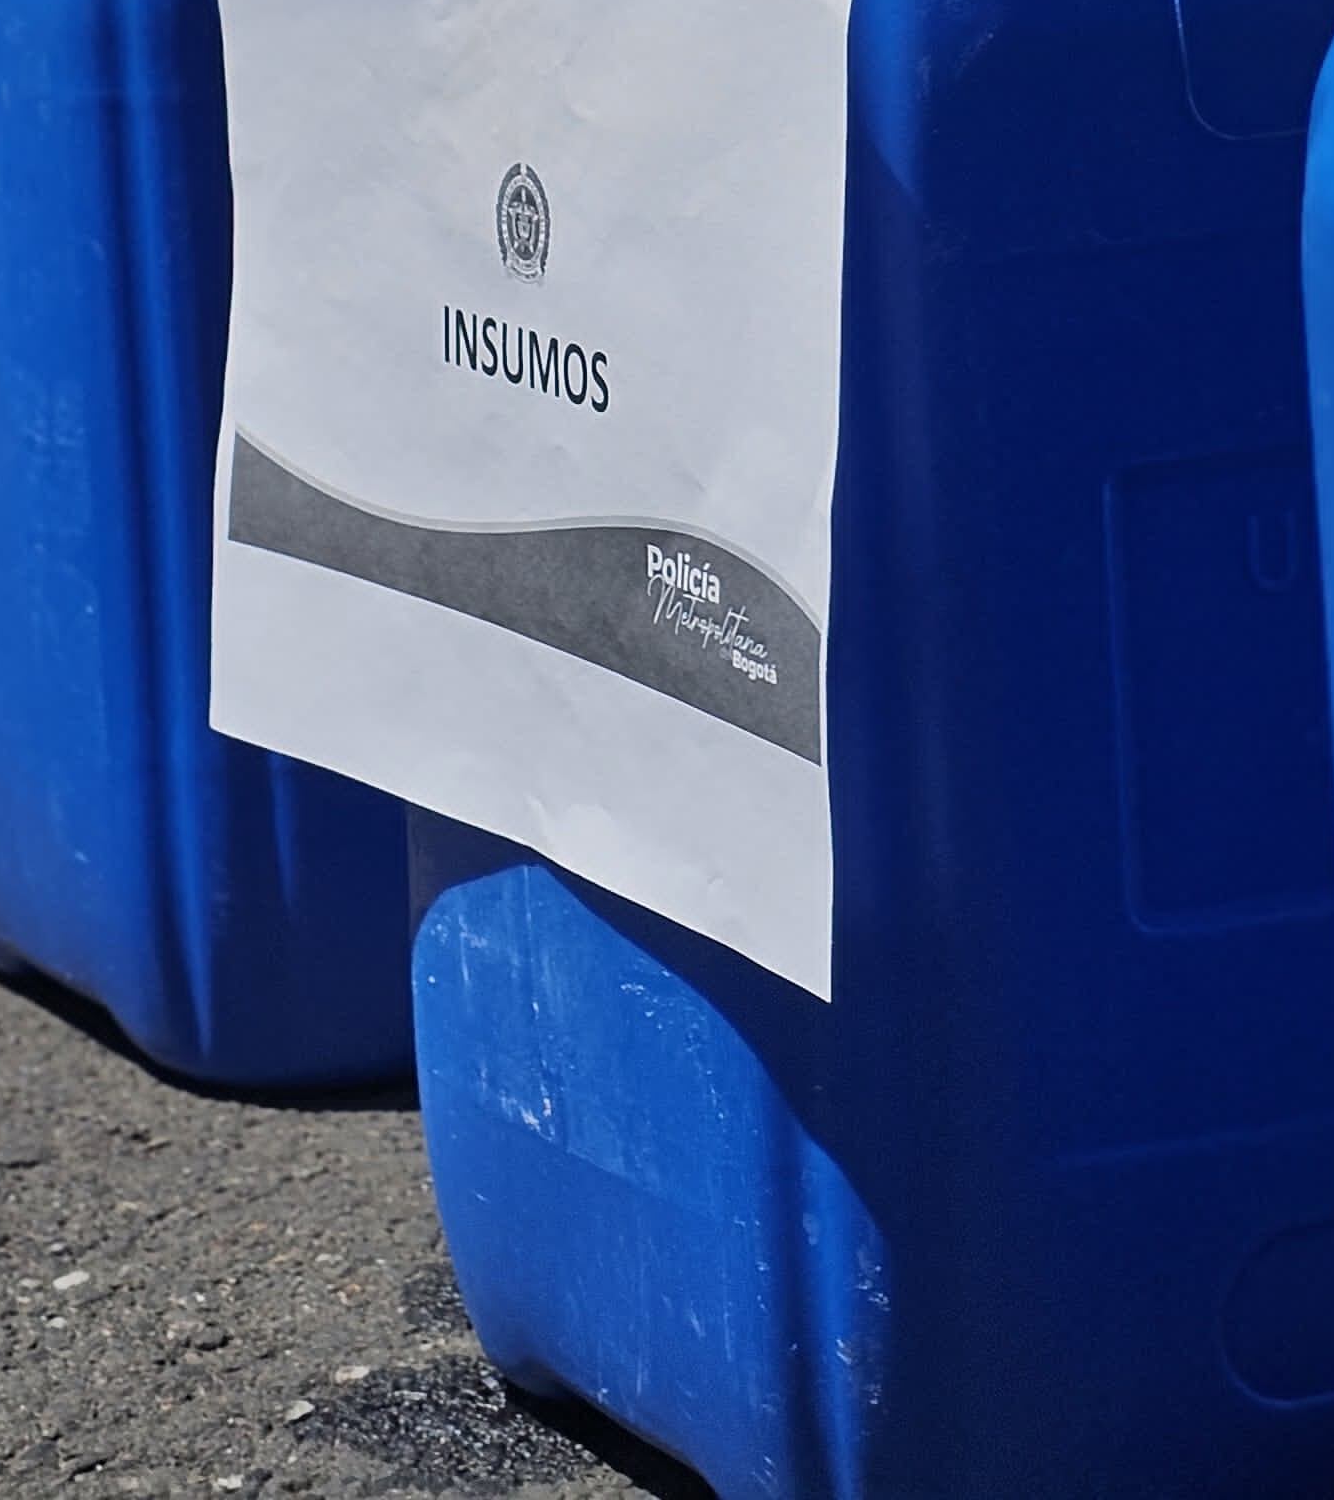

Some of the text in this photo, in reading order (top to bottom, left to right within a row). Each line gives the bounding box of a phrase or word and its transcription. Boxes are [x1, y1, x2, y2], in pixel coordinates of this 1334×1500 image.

[444, 305, 608, 412] INSUMOS
[646, 543, 720, 605] Policía
[647, 573, 768, 658] Metropolitana
[732, 649, 778, 685] Bogotá
